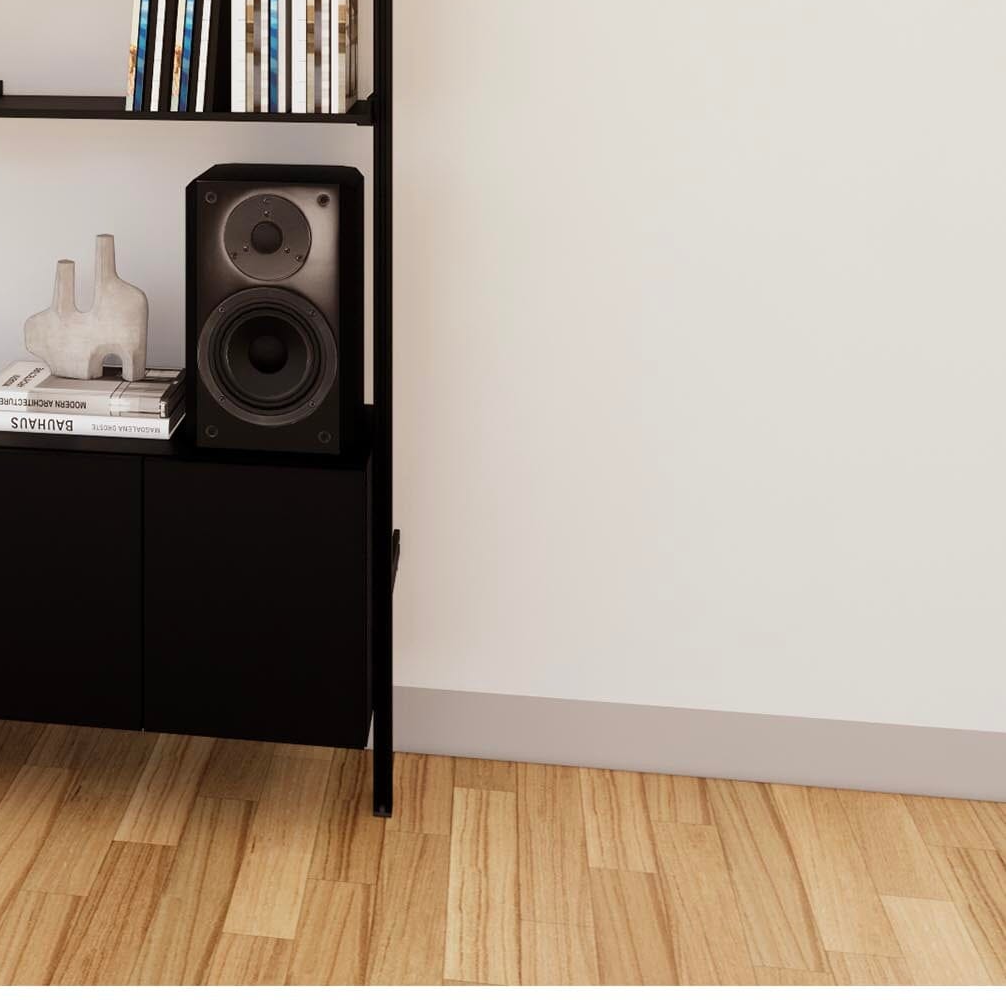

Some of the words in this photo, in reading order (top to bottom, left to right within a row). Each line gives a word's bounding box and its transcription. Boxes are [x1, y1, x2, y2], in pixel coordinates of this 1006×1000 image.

[0, 397, 53, 408] ARCHITECTURE
[54, 400, 87, 409] MODERN
[11, 417, 73, 431] BAUHAUS
